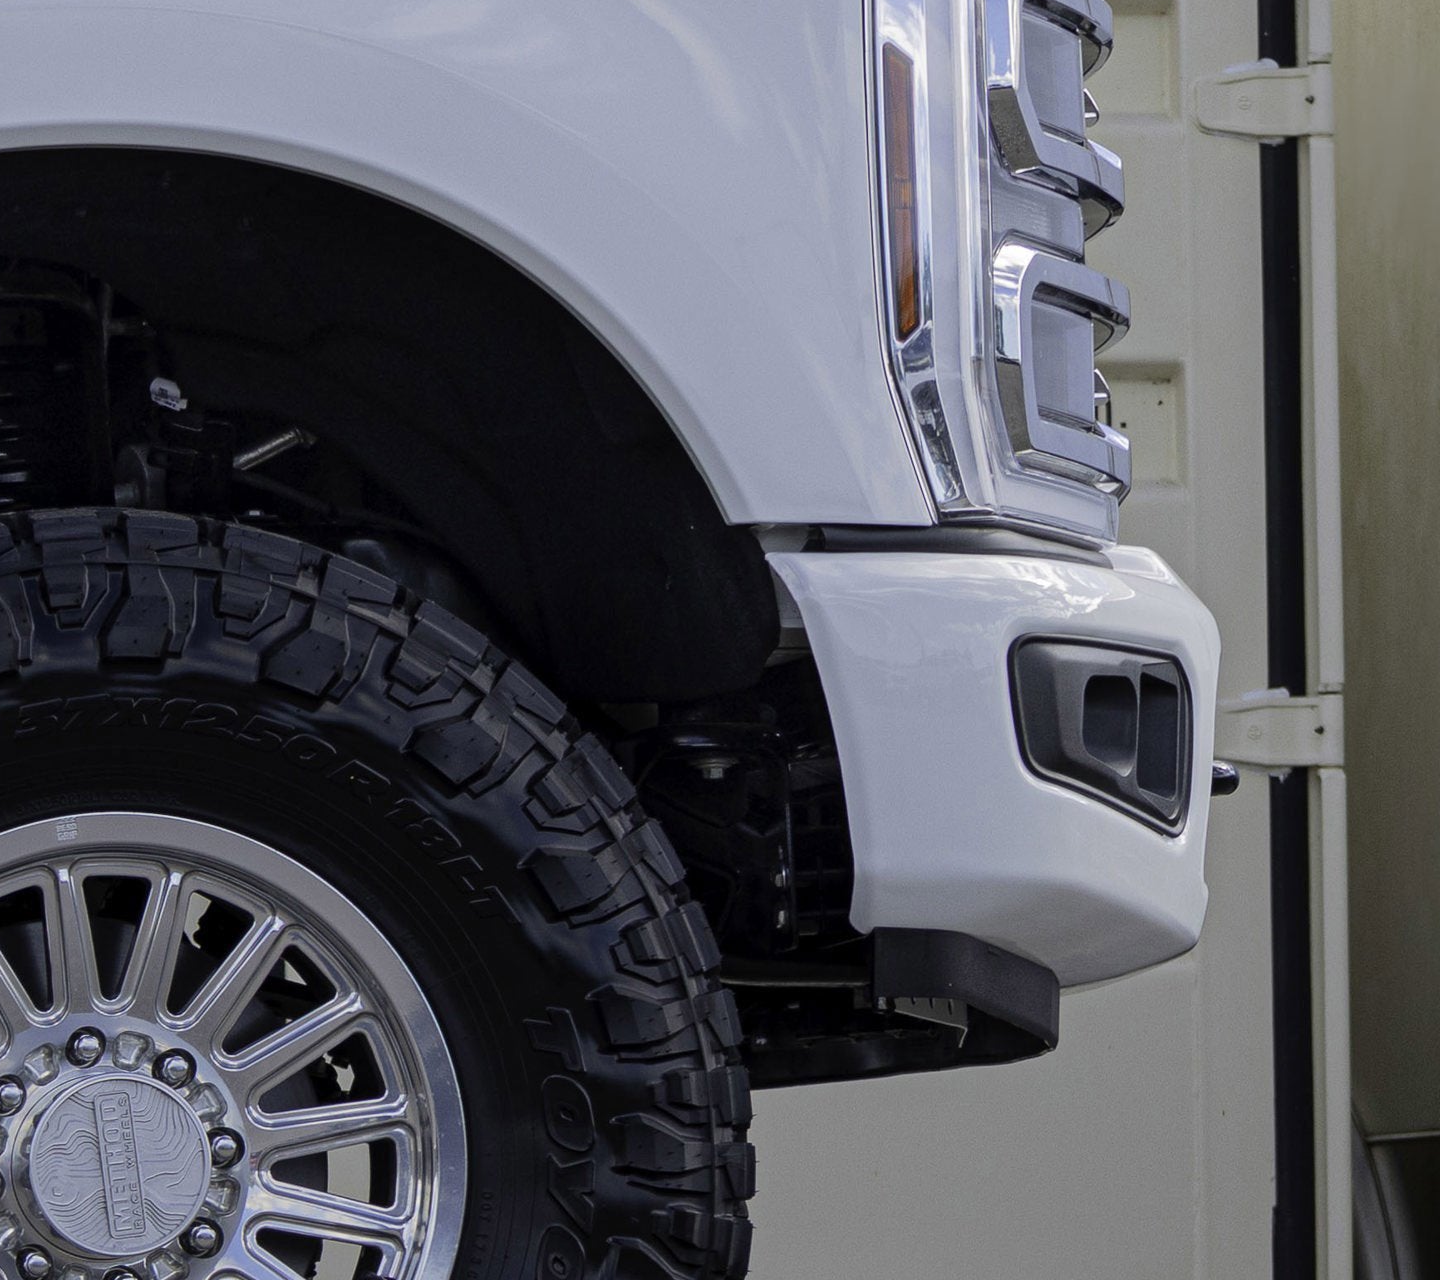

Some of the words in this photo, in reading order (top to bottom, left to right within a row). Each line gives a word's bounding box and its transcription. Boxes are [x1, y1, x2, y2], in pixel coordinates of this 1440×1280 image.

[100, 1096, 133, 1233] METHOD
[117, 1095, 136, 1169] WHEELS
[128, 1182, 144, 1230] RACE
